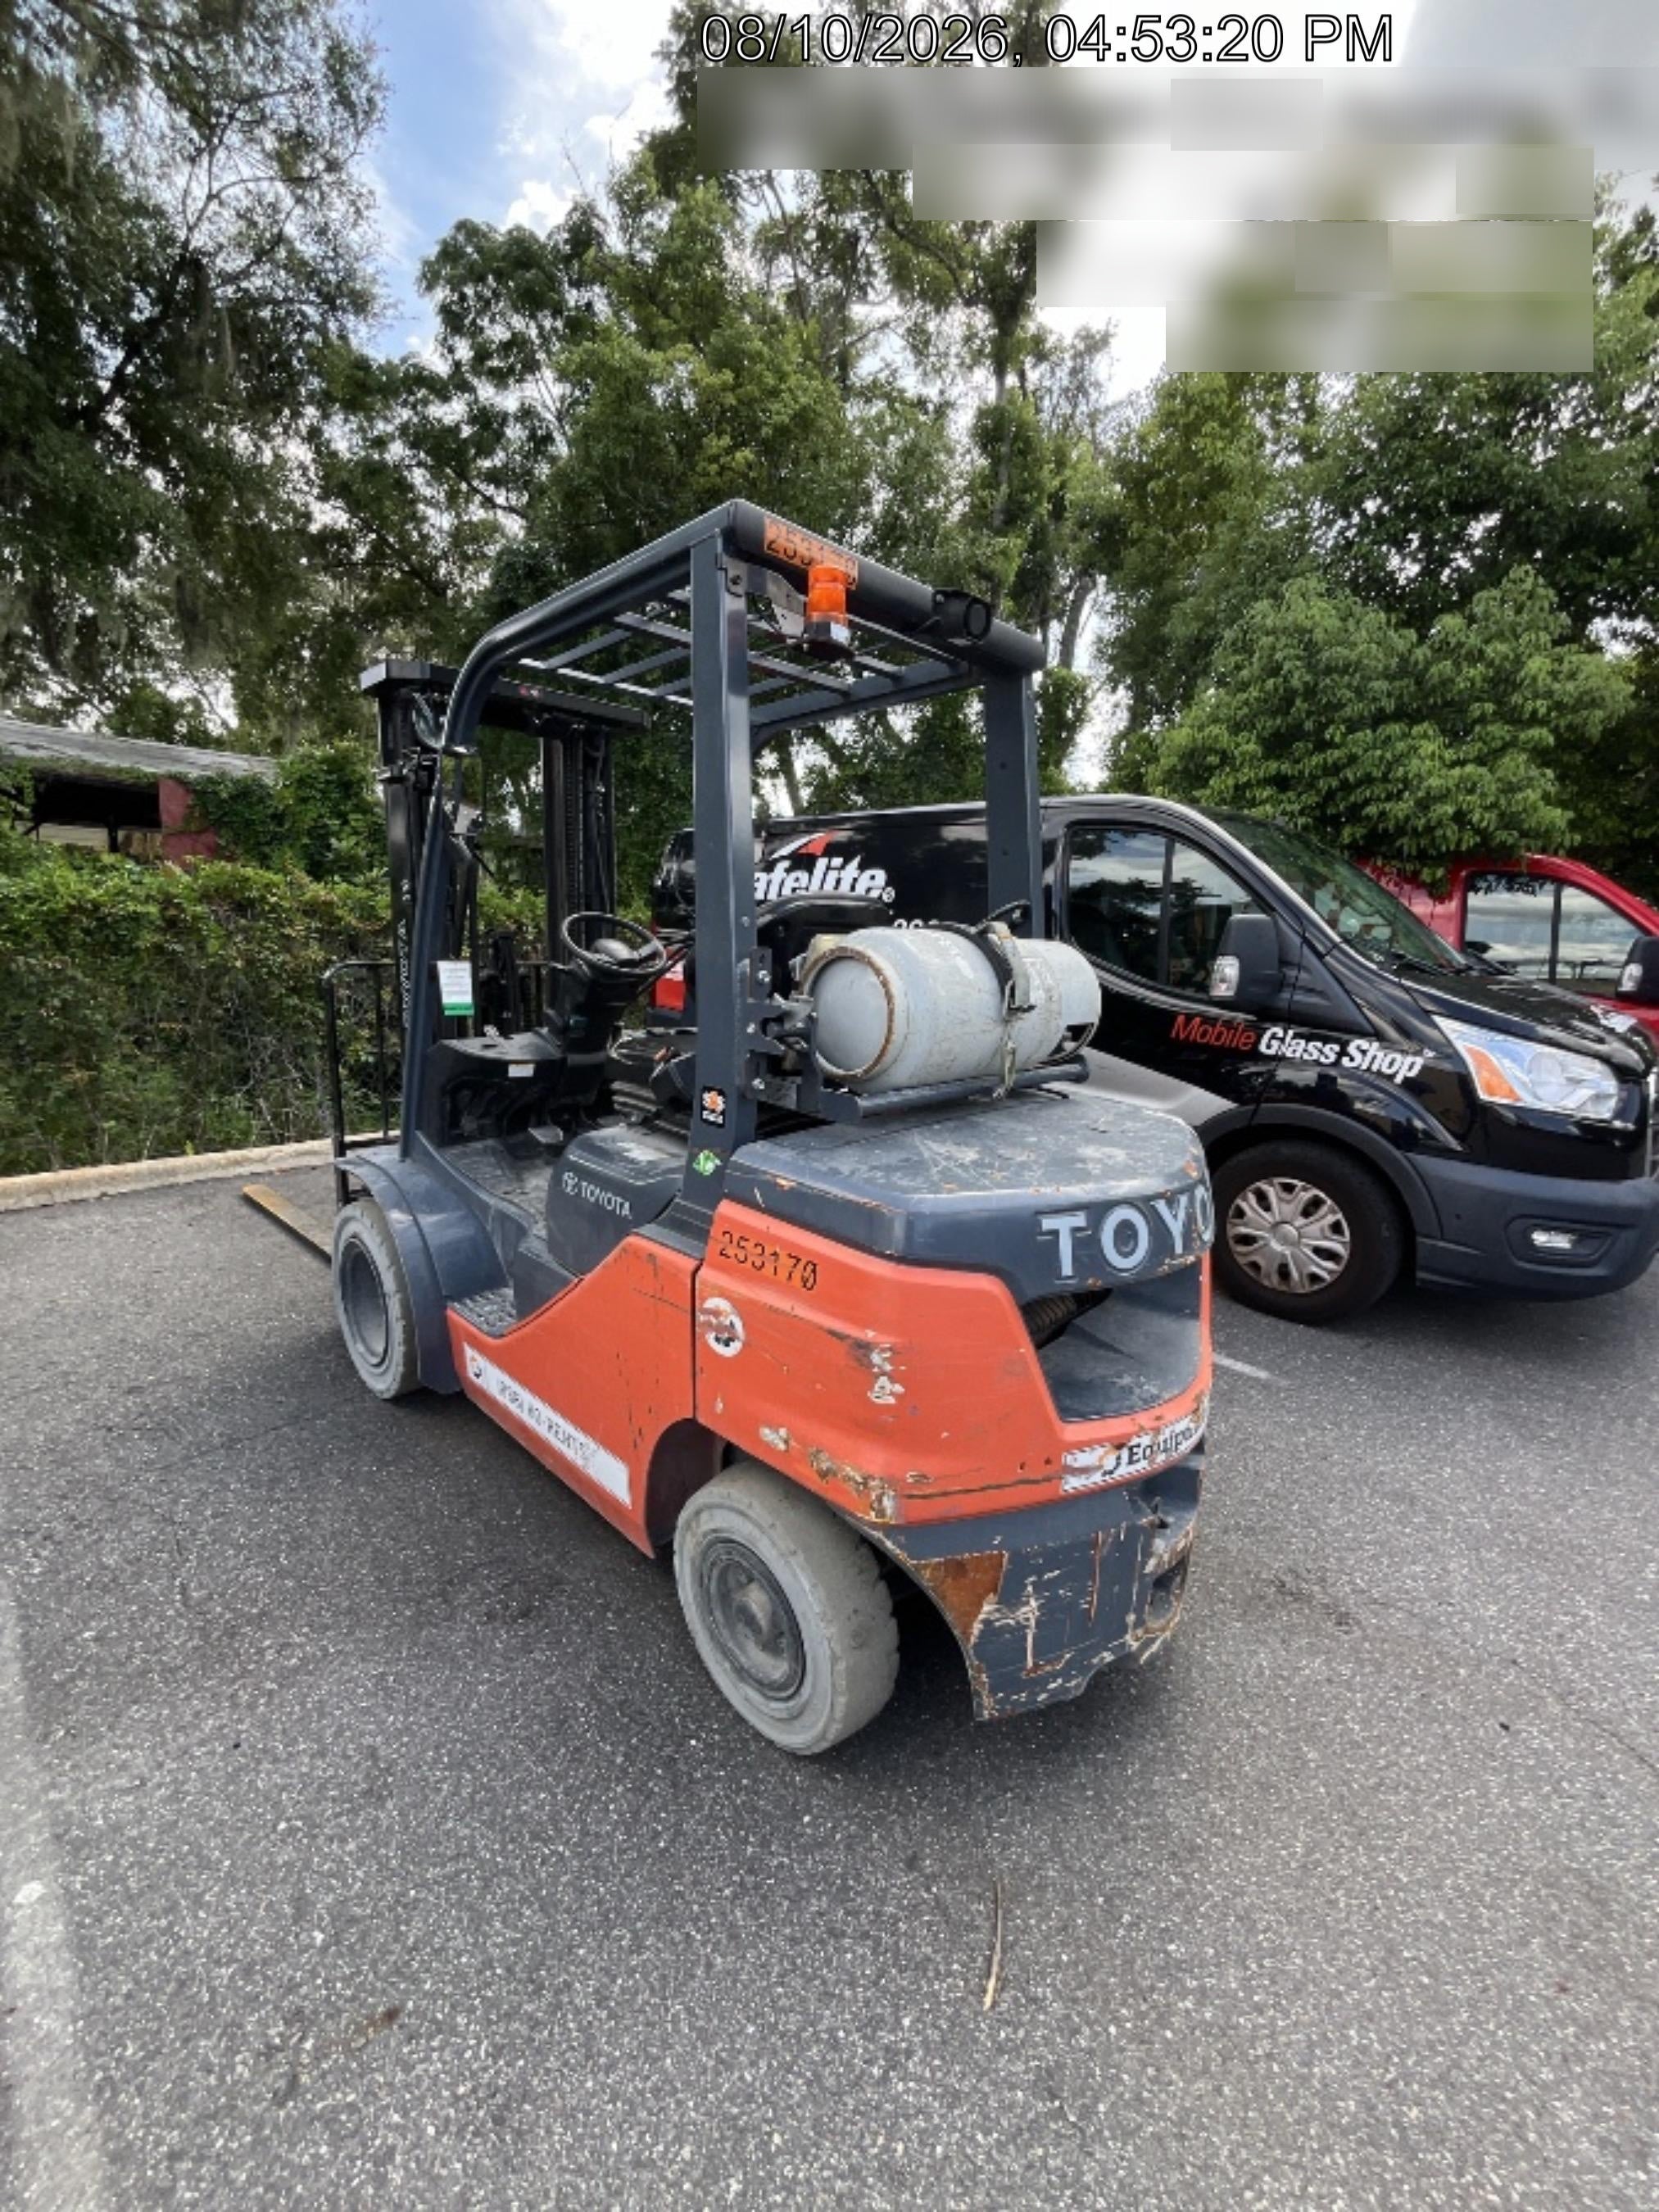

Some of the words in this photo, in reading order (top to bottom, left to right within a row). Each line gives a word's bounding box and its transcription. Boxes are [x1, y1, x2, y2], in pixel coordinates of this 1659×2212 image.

[755, 854, 887, 900] afelite
[1169, 1014, 1258, 1051] Mobile
[1258, 1027, 1340, 1065] Glass
[1341, 1038, 1424, 1085] Shop
[581, 1181, 632, 1220] TOYOTA
[719, 1231, 818, 1291] 253170
